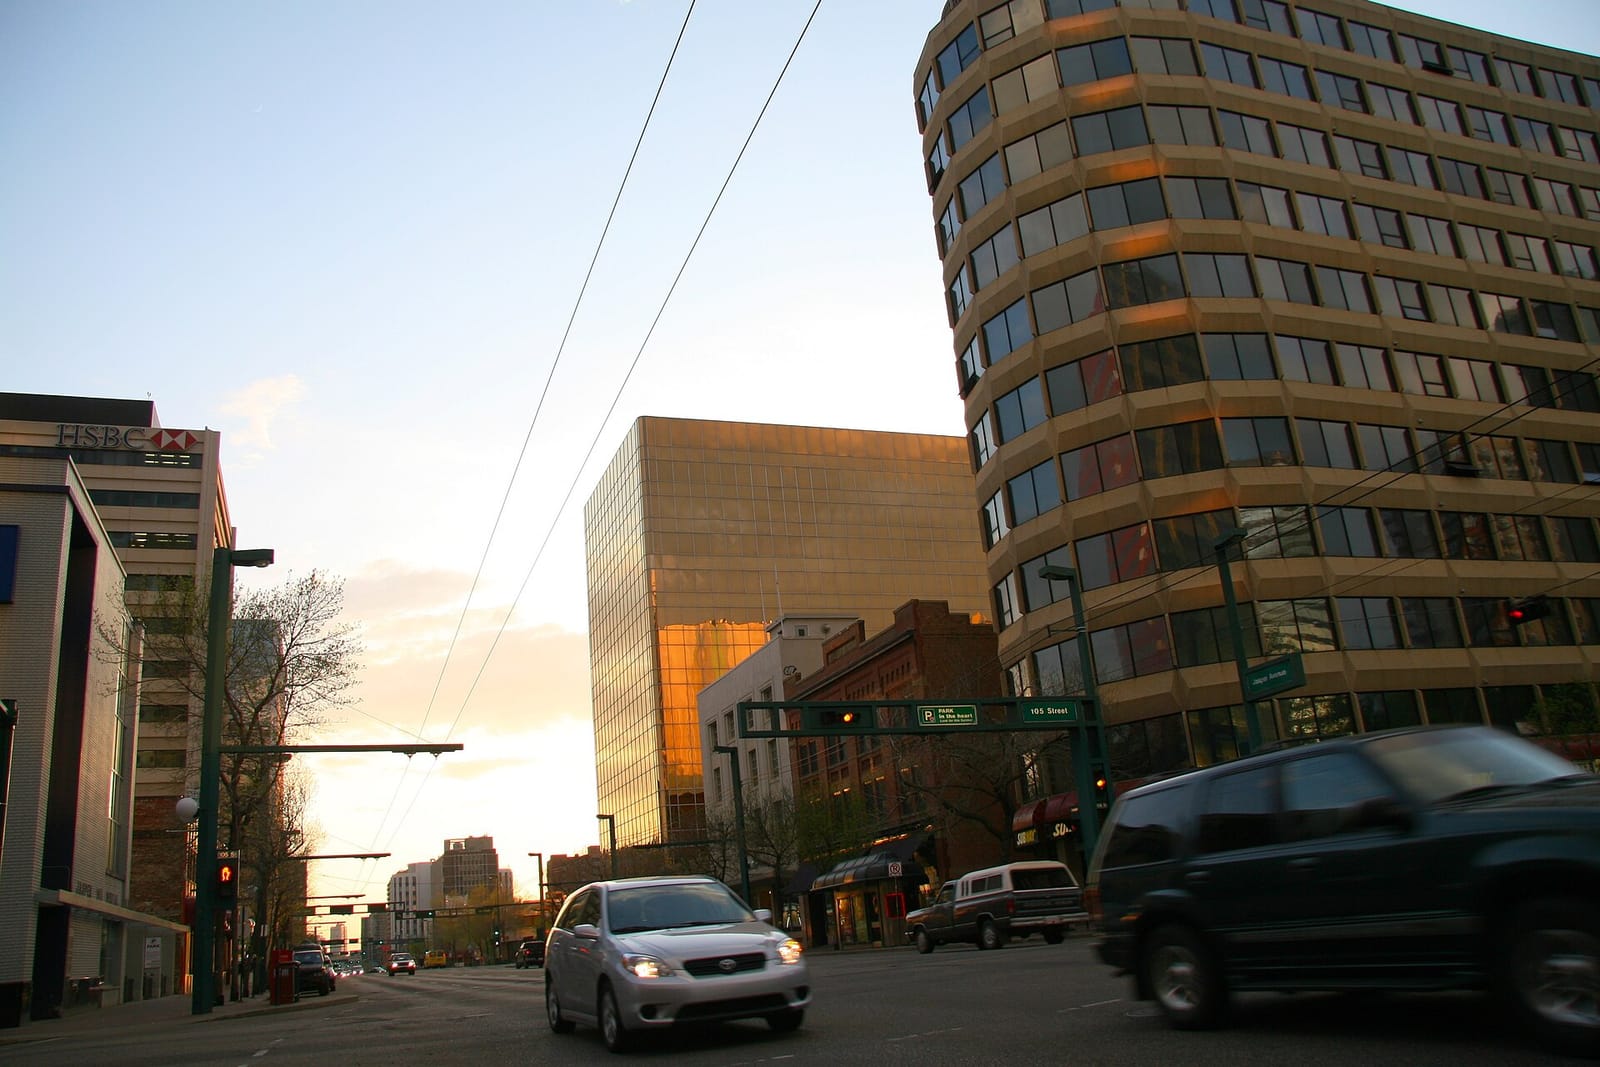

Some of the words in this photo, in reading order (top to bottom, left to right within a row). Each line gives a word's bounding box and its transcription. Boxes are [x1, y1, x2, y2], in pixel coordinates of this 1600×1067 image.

[56, 424, 146, 450] HSBC
[1030, 707, 1045, 715] 105
[1047, 706, 1069, 715] Street
